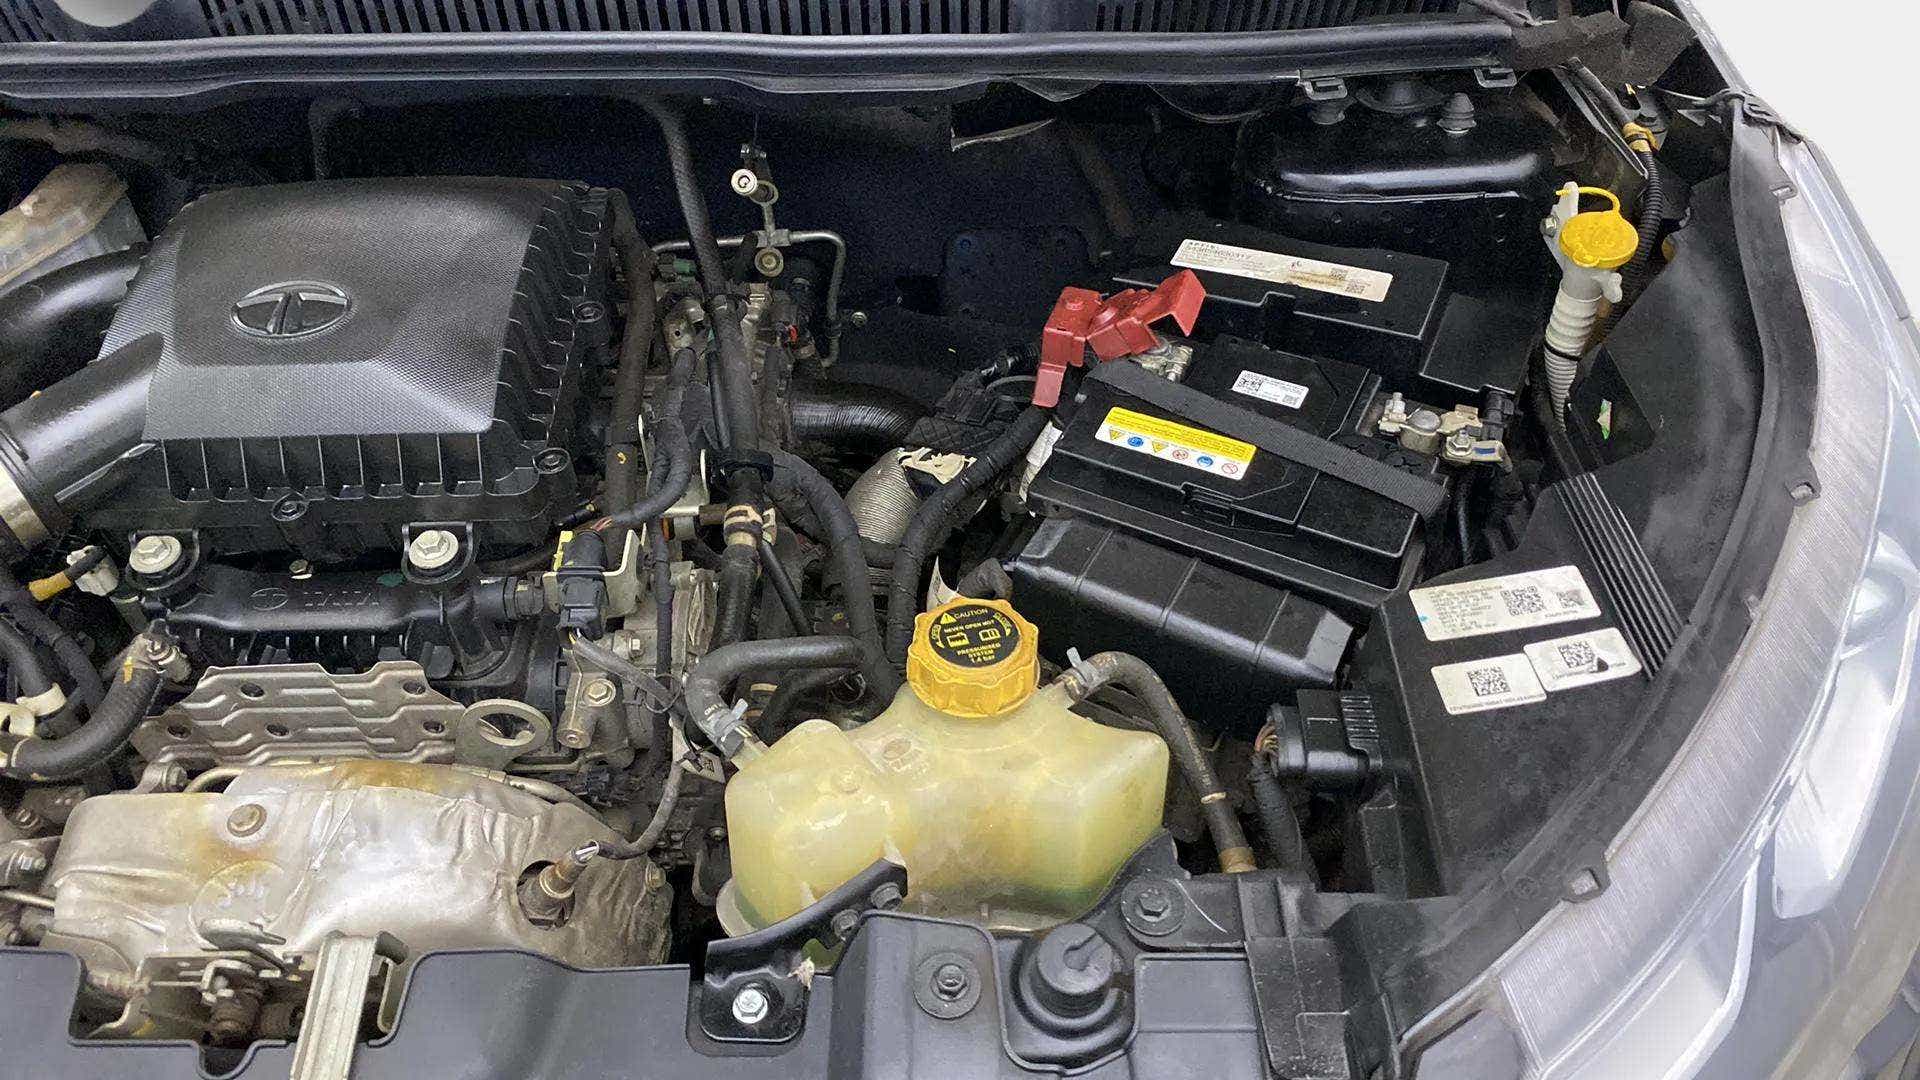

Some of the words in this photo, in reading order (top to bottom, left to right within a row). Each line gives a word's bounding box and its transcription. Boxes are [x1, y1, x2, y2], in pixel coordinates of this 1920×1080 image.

[954, 608, 988, 618] CAUTION
[943, 625, 964, 633] NEVER
[964, 622, 982, 630] OPEN
